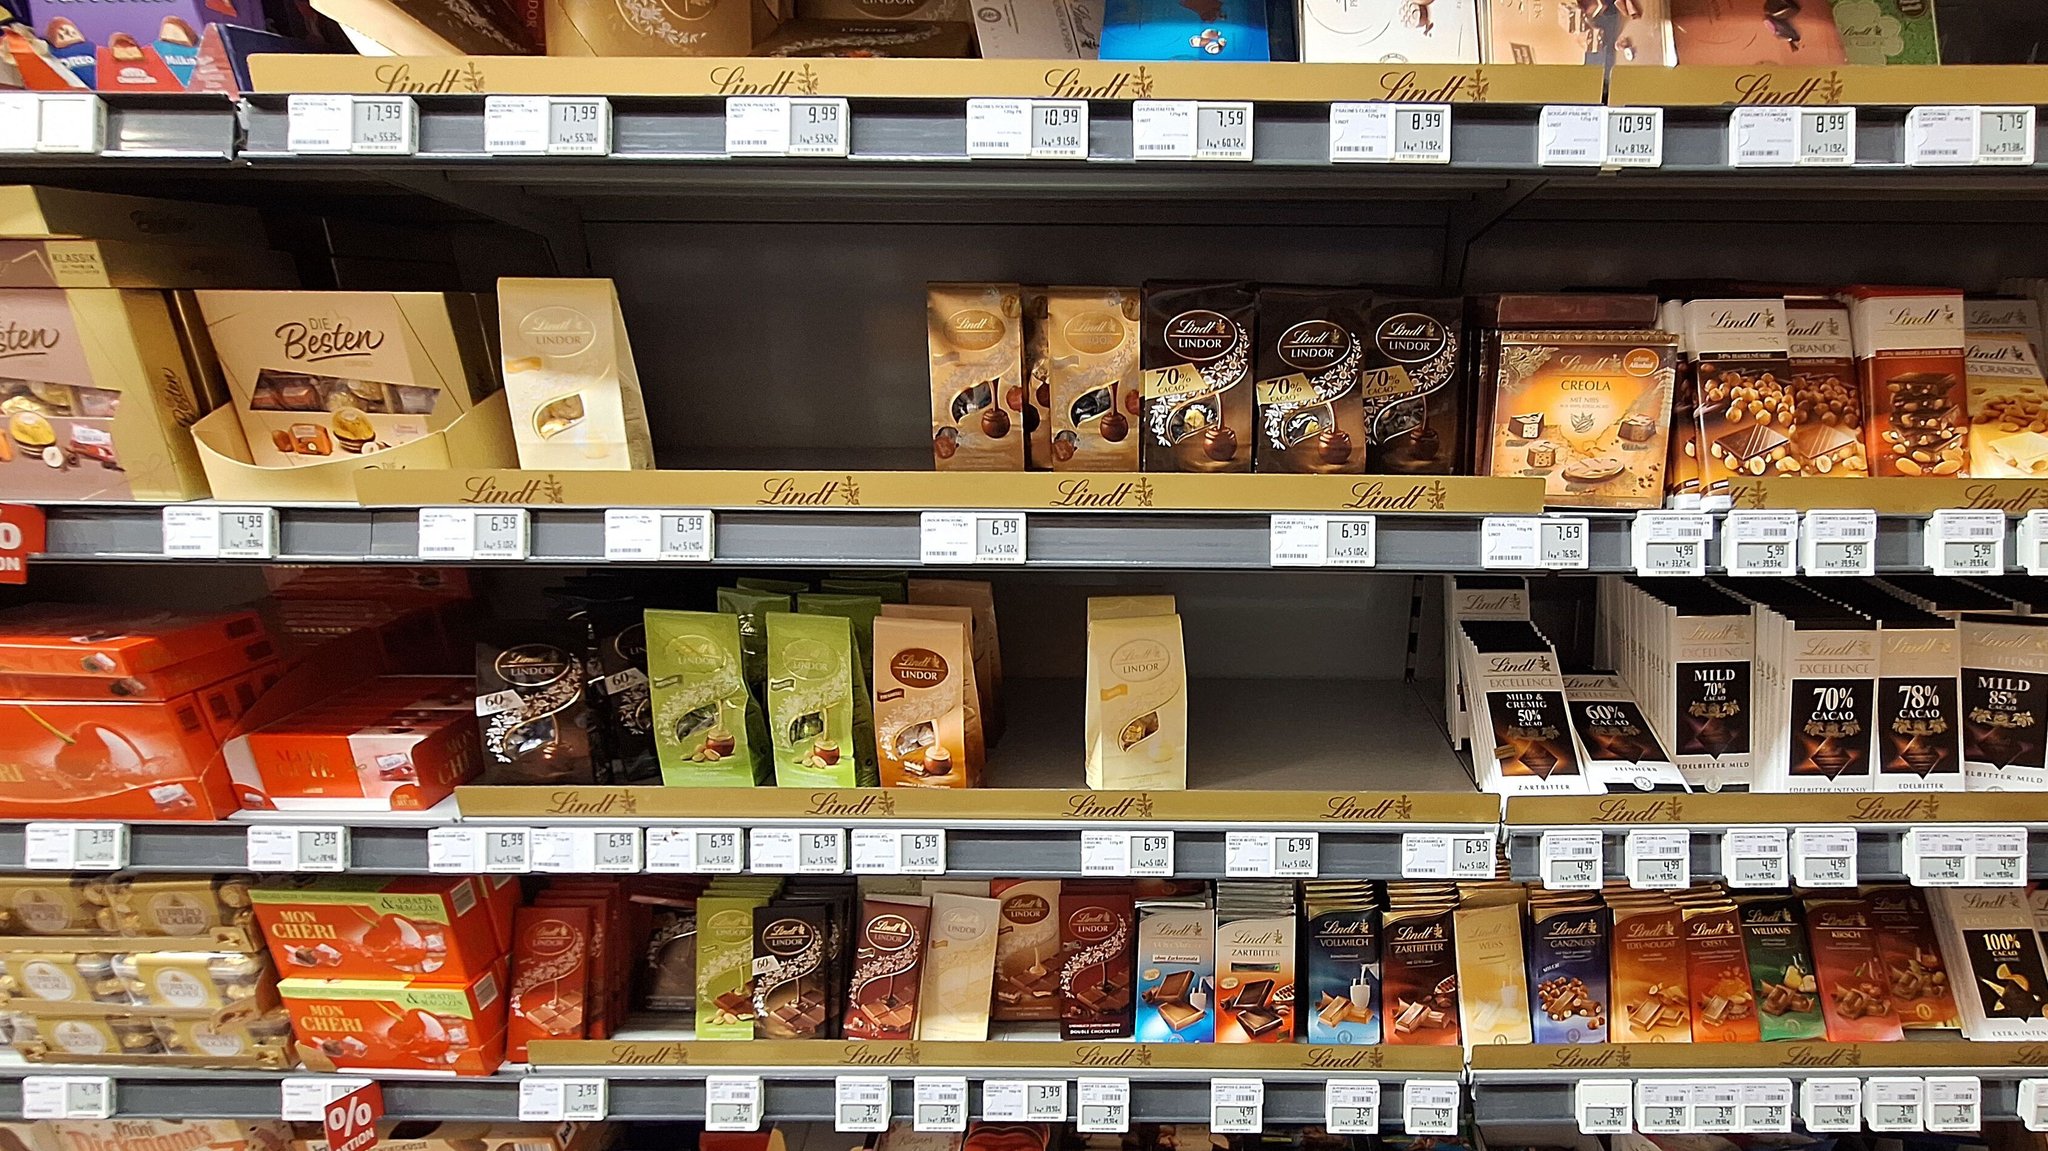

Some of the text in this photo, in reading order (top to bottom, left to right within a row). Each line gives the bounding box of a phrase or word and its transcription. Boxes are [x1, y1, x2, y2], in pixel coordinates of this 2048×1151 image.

[375, 63, 460, 93] Lindt
[710, 66, 795, 94] Lindt
[1045, 67, 1130, 98] Lindt
[1380, 71, 1466, 102] Lindt
[1735, 73, 1820, 104] Lindt
[366, 105, 401, 122] 17.99
[563, 106, 597, 123] 17.99
[808, 107, 837, 124] 9.99
[1044, 109, 1078, 126] 10.99
[1216, 110, 1243, 128] 7.59
[1412, 114, 1441, 130] 8.99
[1618, 116, 1652, 133] 10.99
[1816, 115, 1844, 133] 8.99
[309, 317, 330, 331] DIE
[956, 315, 987, 329] Lindt
[1890, 307, 1939, 327] Lindt
[1177, 319, 1213, 334] Lindt
[1391, 322, 1429, 336] Lindt
[275, 323, 385, 359] Besten
[536, 335, 581, 345] LINDOR
[1178, 338, 1222, 348] LINDOR
[1289, 329, 1329, 344] Lindt
[1389, 340, 1430, 351] LINDOR
[1291, 348, 1334, 358] LINDOR
[1559, 354, 1606, 371] Lindt
[1156, 368, 1191, 386] 70%
[1366, 371, 1400, 388] 70%
[1157, 385, 1186, 393] CACAO
[1266, 379, 1302, 395] 70%
[1367, 385, 1394, 394] CACAO
[1561, 380, 1611, 391] CREOLA
[1270, 392, 1297, 401] CACAO
[459, 476, 542, 504] Lindt
[757, 477, 839, 505] Lindt
[1050, 479, 1133, 507] Lindt
[1342, 482, 1427, 509] Lindt
[1954, 483, 2039, 509] Lindt
[237, 515, 262, 532] 4.99
[491, 517, 516, 532] 6.99
[677, 518, 702, 533] 6.99
[992, 520, 1017, 536] 6.99
[1342, 523, 1367, 538] 6.99
[1557, 525, 1580, 540] 7.69
[1675, 545, 1694, 558] 4.99
[1767, 545, 1785, 558] 5.99
[1845, 545, 1863, 558] 5.99
[1974, 545, 1991, 558] 5.99
[1463, 595, 1506, 611] Lindt
[1803, 637, 1855, 656] Lindt
[1887, 637, 1932, 654] Lindt
[899, 654, 931, 667] Lindt
[1490, 657, 1535, 673] Lindt
[511, 667, 554, 676] LINDOR
[901, 671, 938, 680] LINDOR
[1123, 663, 1159, 674] LINDOR
[1695, 669, 1735, 681] MILD
[1799, 663, 1869, 674] EXCELLENCE
[1490, 678, 1554, 688] EXCELLENCE
[1704, 682, 1726, 695] 70%
[1978, 676, 2031, 692] MILD
[1536, 693, 1543, 701] &
[1812, 687, 1854, 711] 70%
[1898, 685, 1939, 709] 78%
[1988, 691, 2017, 705] 85%
[1506, 701, 1547, 709] CREMIG
[1517, 709, 1541, 722] 50%
[1586, 705, 1626, 721] 60%
[1812, 711, 1854, 720] CACAO
[1899, 709, 1939, 718] CACAO
[1590, 719, 1629, 727] CACAO
[1677, 762, 1725, 770] EDELBITTER
[2017, 775, 2043, 784] MILD
[546, 791, 618, 814] Lindt
[805, 792, 876, 816] Lindt
[1062, 794, 1135, 818] Lindt
[1320, 796, 1394, 819] Lindt
[1848, 797, 1922, 820] Lindt
[1591, 799, 1663, 822] Lindt
[314, 832, 336, 846] 2.99
[501, 834, 522, 847] 6.99
[610, 835, 631, 848] 6.99
[711, 834, 732, 848] 6.99
[814, 835, 836, 849] 6.99
[915, 835, 936, 849] 6.99
[1144, 838, 1166, 851] 6.99
[1289, 838, 1310, 852] 6.99
[1577, 861, 1593, 873] 4.99
[1663, 860, 1680, 873] 4.99
[1761, 860, 1777, 873] 4.99
[1831, 859, 1846, 871] 4.99
[1946, 859, 1961, 871] 4.99
[2000, 859, 2016, 871] 4.99
[1963, 892, 2006, 909] Lindt
[280, 911, 317, 923] MON
[1010, 910, 1041, 918] LINDOR
[1746, 909, 1783, 923] Lindt
[271, 923, 337, 939] CHERI
[877, 920, 906, 932] Lindt
[1078, 925, 1109, 933] LINDOR
[1157, 922, 1192, 936] Lindt
[1320, 918, 1359, 935] Lindt
[1398, 923, 1433, 941] Lindt
[1549, 922, 1587, 937] Lindt
[1627, 922, 1665, 937] Lindt
[1692, 923, 1726, 937] Lindt
[1751, 926, 1791, 936] WILLIAMS
[874, 934, 908, 942] LINDOR
[1233, 929, 1272, 945] Lindt
[1831, 930, 1861, 939] KIRSCH
[772, 938, 803, 946] LINDOR
[1319, 937, 1369, 948] VOLLMILCH
[1395, 943, 1444, 953] ZARTBITTER
[1551, 939, 1596, 948] GANZNUSS
[1701, 939, 1727, 948] CRESTA
[1983, 933, 2021, 951] 100%
[1231, 949, 1281, 957] ZARTBITTER
[310, 1005, 344, 1017] MON
[300, 1016, 363, 1032] CHERI
[607, 1044, 672, 1065] Lindt
[842, 1044, 904, 1065] Lindt
[1070, 1046, 1137, 1066] Lindt
[1301, 1048, 1368, 1067] Lindt
[1549, 1048, 1616, 1067] Lindt
[1780, 1045, 1846, 1066] Lindt
[1041, 1086, 1061, 1100] 3.99
[328, 1096, 372, 1137] %
[1106, 1106, 1121, 1118] 3.99
[1239, 1106, 1254, 1118] 4.99
[1356, 1107, 1371, 1120] 3.29
[1434, 1108, 1449, 1121] 4.99
[1609, 1107, 1624, 1119] 3.99
[1669, 1107, 1683, 1119] 3.99
[1719, 1107, 1733, 1119] 3.99
[1769, 1107, 1783, 1119] 3.99
